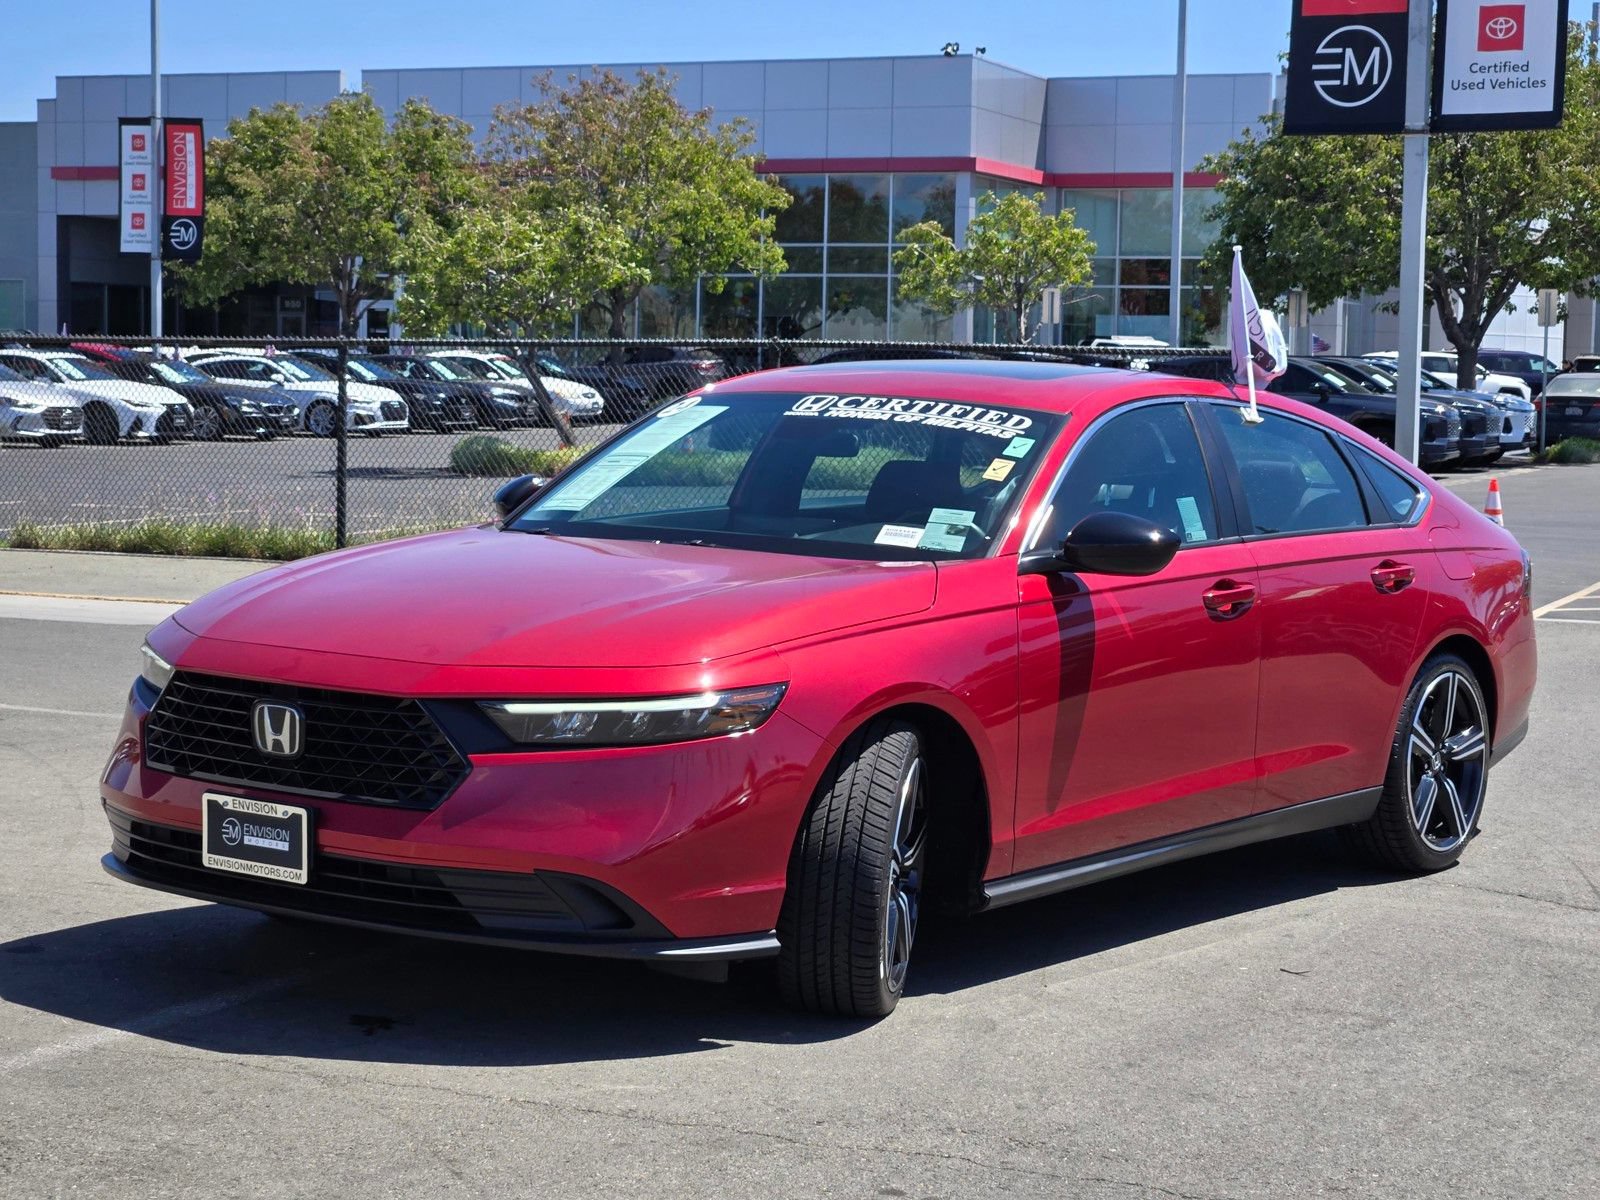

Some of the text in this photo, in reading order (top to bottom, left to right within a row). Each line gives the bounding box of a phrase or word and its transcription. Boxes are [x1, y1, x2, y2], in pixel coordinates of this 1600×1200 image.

[1468, 60, 1530, 75] Certified
[1451, 76, 1547, 91] Used Vehicles
[173, 132, 186, 209] ENVISION
[837, 396, 1033, 429] CERTIFIED
[823, 409, 1018, 440] HONDA OF MILPITAS
[232, 799, 278, 815] ENVISION
[243, 823, 290, 841] ENVISION
[207, 856, 302, 882] ENVISIONMOTORS.COM
